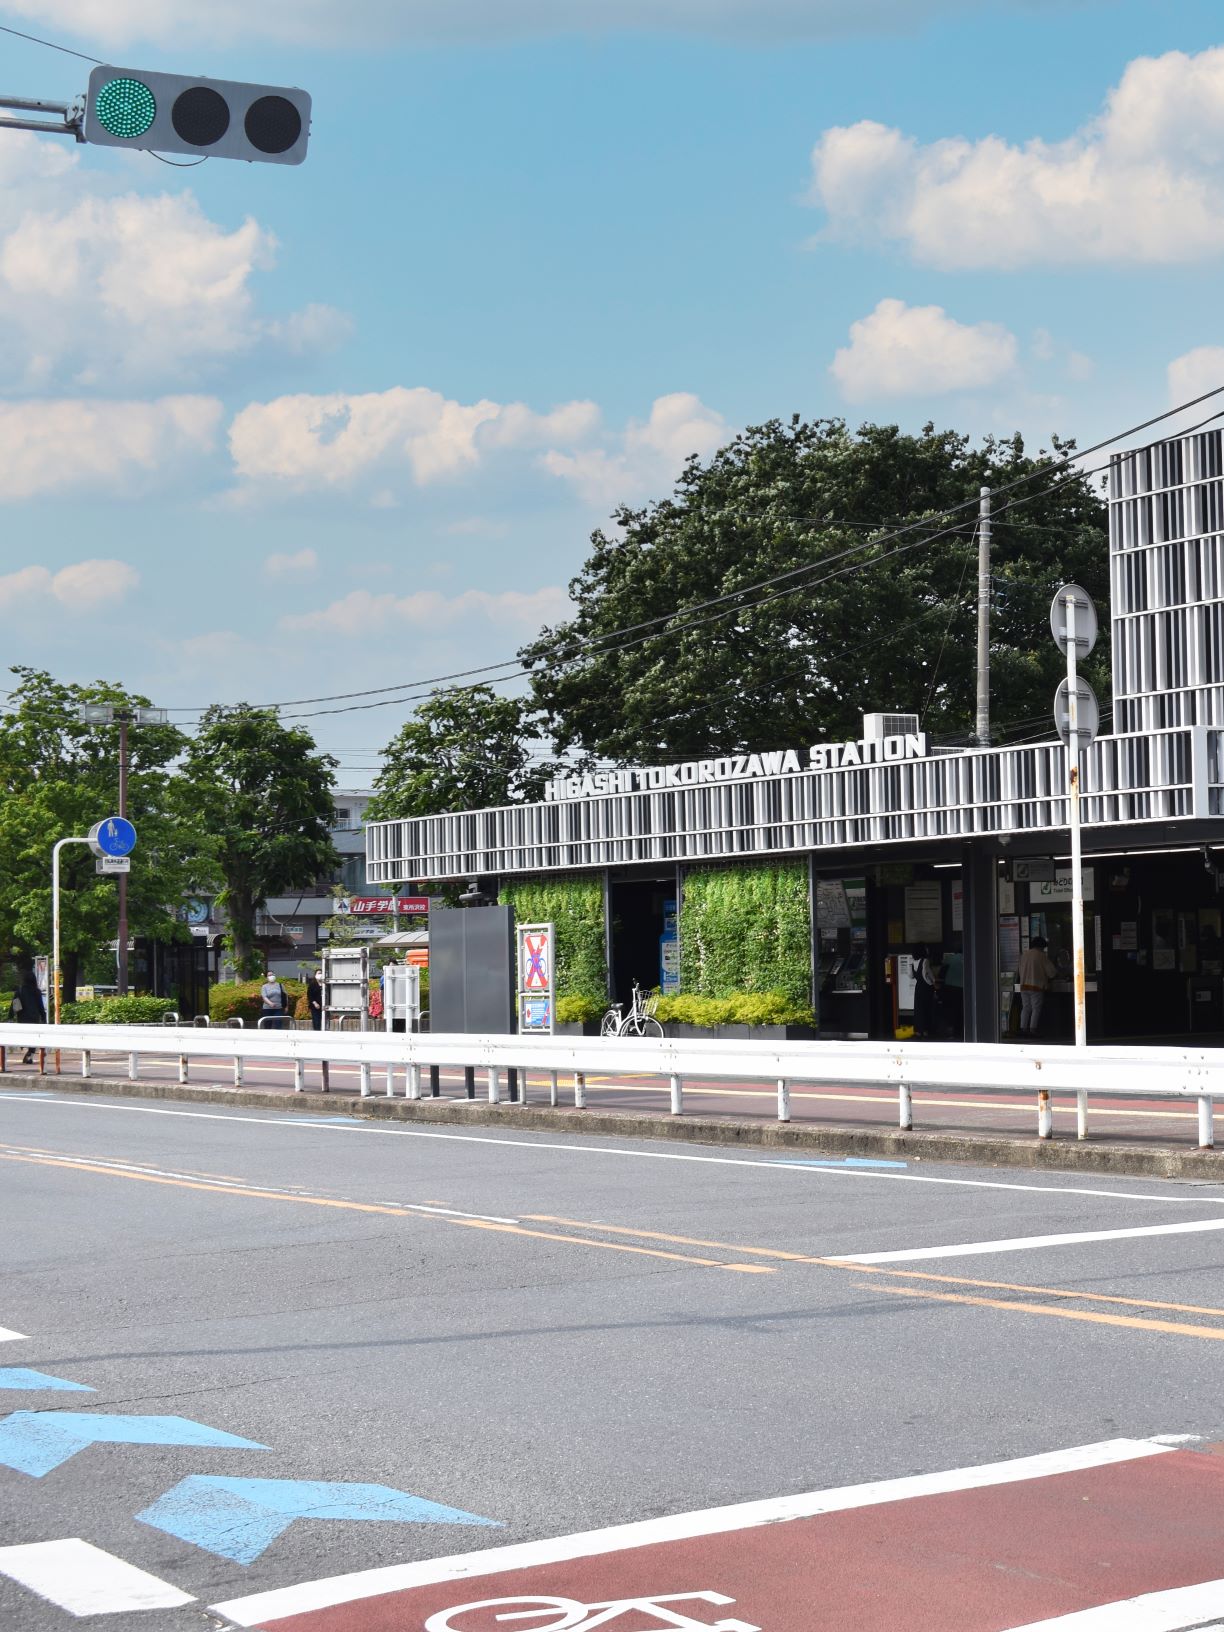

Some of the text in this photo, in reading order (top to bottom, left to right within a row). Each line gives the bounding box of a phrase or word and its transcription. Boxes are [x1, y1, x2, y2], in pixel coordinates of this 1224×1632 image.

[545, 732, 927, 801] HIGASHI TOKOROZAWA STATION
